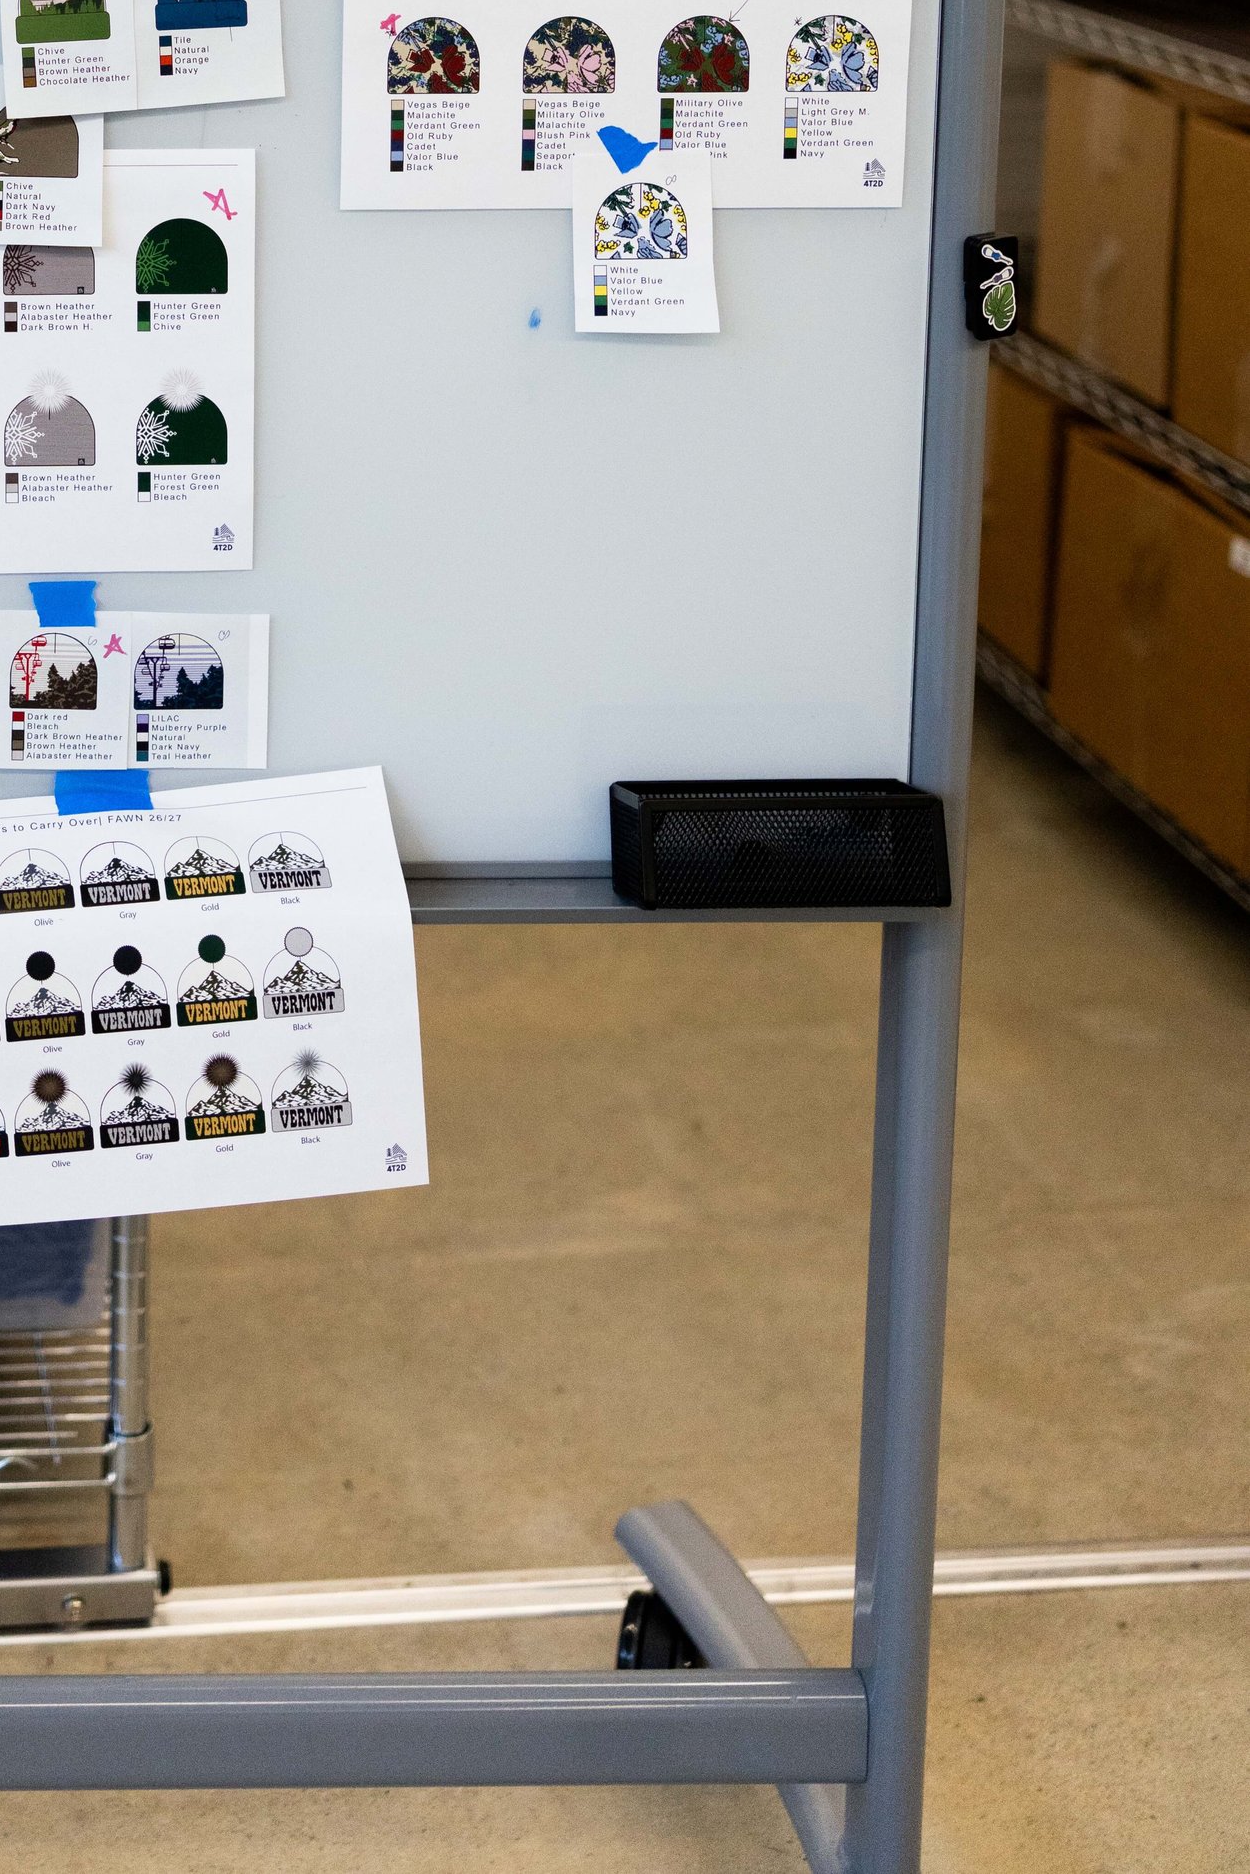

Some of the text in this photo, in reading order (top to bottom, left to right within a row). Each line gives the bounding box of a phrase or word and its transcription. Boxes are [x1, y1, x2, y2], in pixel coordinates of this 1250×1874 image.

[407, 111, 456, 120] Malachite
[153, 301, 221, 310] Hunter Green
[151, 714, 180, 723] LILAC
[12, 824, 25, 833] to
[29, 821, 64, 835] Carry
[107, 813, 144, 825] FAWN
[148, 814, 182, 822] 26/27
[173, 874, 235, 896] VERMONT
[258, 870, 322, 889] VERMONT
[2, 889, 66, 910] VERMONT
[200, 902, 220, 912] Gold
[280, 896, 301, 905] Black
[33, 917, 54, 927] Olive
[185, 999, 248, 1023] VERMONT
[272, 991, 335, 1015] VERMONT
[13, 1016, 77, 1038] VERMONT
[193, 1113, 255, 1137] VERMONT
[280, 1105, 343, 1128] VERMONT
[22, 1130, 85, 1152] VERMONT
[386, 1162, 407, 1173] 4T2D
